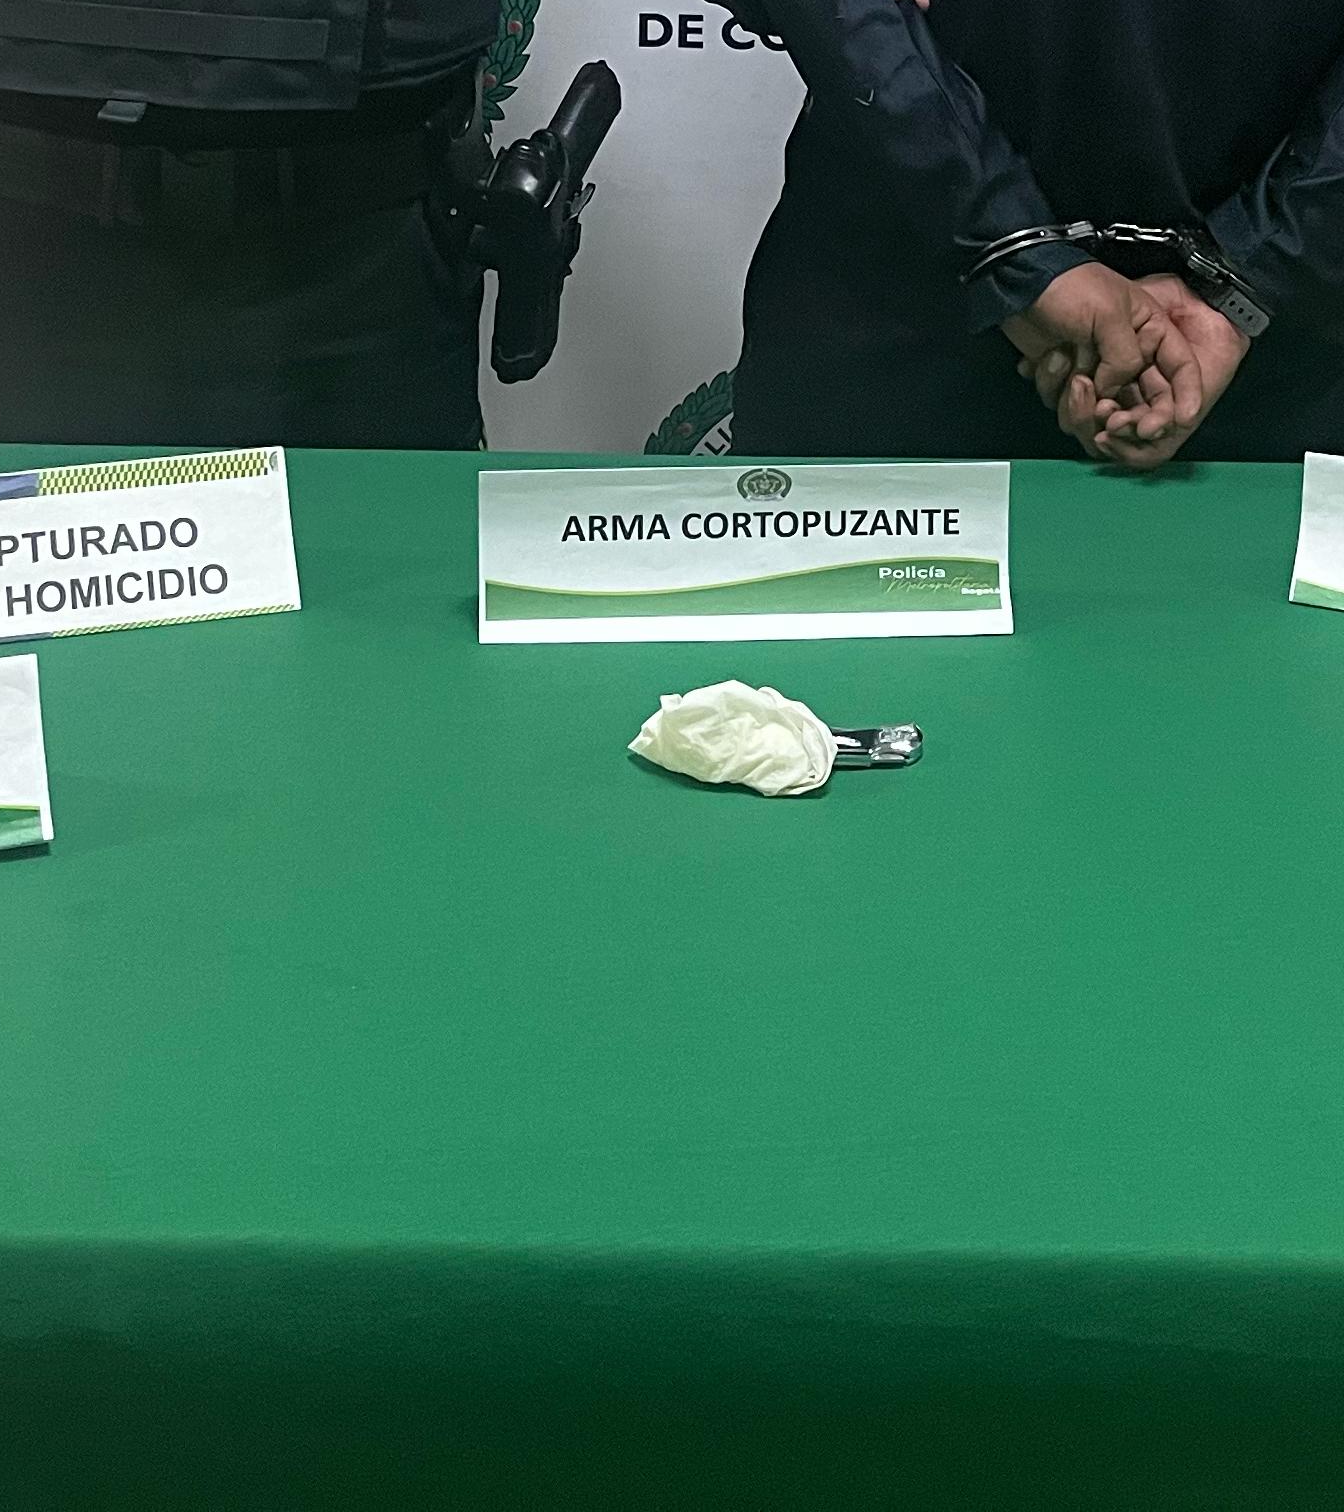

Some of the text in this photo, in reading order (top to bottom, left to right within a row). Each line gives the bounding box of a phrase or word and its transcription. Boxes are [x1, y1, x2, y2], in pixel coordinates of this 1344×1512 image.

[639, 13, 703, 49] DE
[562, 509, 959, 541] ARMA CORTOPUZANTE
[878, 565, 946, 579] Policía
[6, 564, 227, 617] HOMICIDIO
